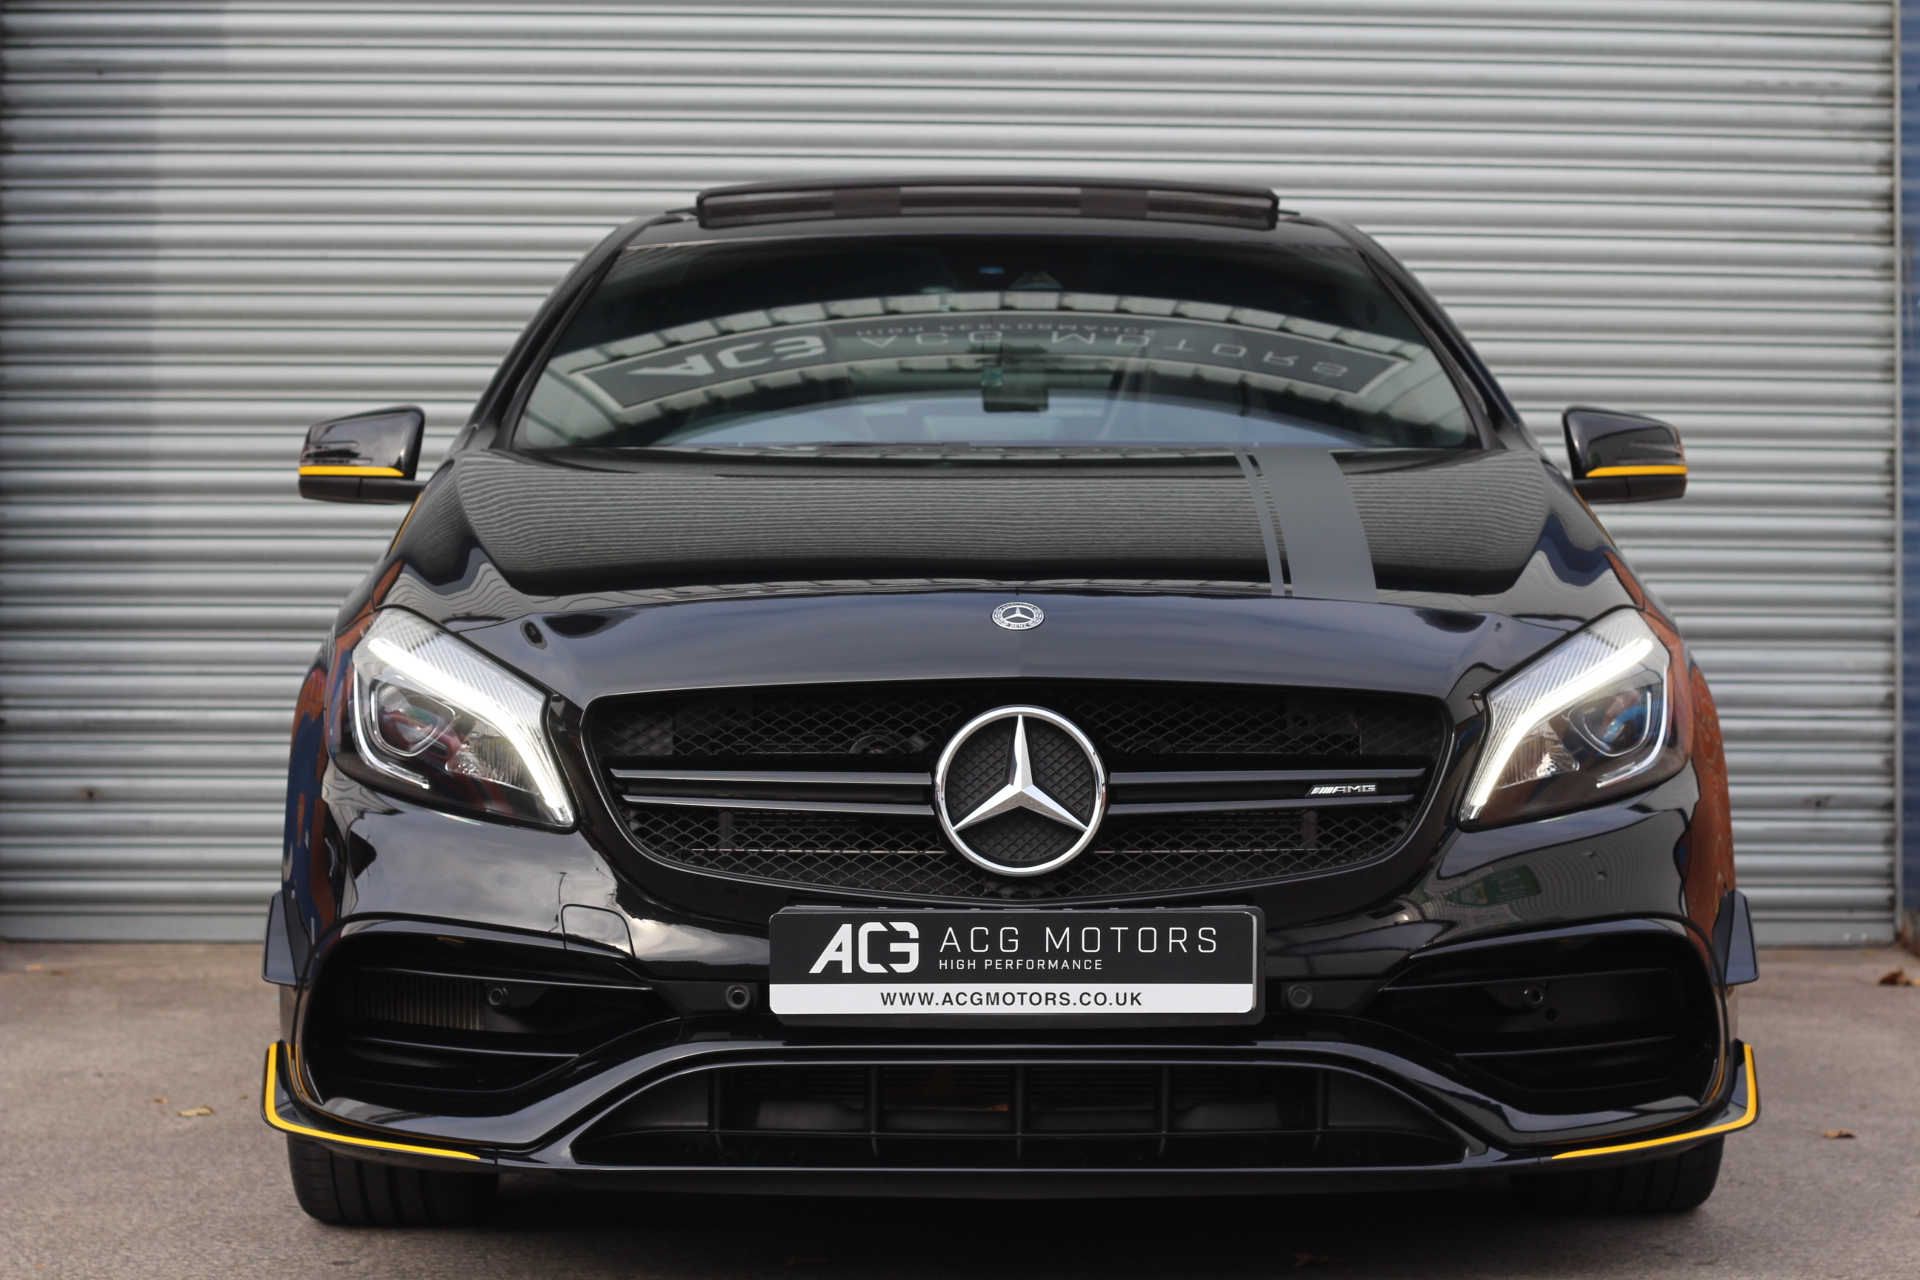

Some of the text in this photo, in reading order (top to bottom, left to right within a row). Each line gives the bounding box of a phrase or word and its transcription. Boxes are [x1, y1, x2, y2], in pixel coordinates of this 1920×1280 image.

[1331, 784, 1376, 794] AMG
[808, 921, 919, 973] ACG
[940, 926, 1217, 953] ACG MOTORS
[939, 959, 1103, 970] HIGH PERFORMANCE
[880, 991, 1142, 1006] WWW.ACGMOTORS.CO.UK
